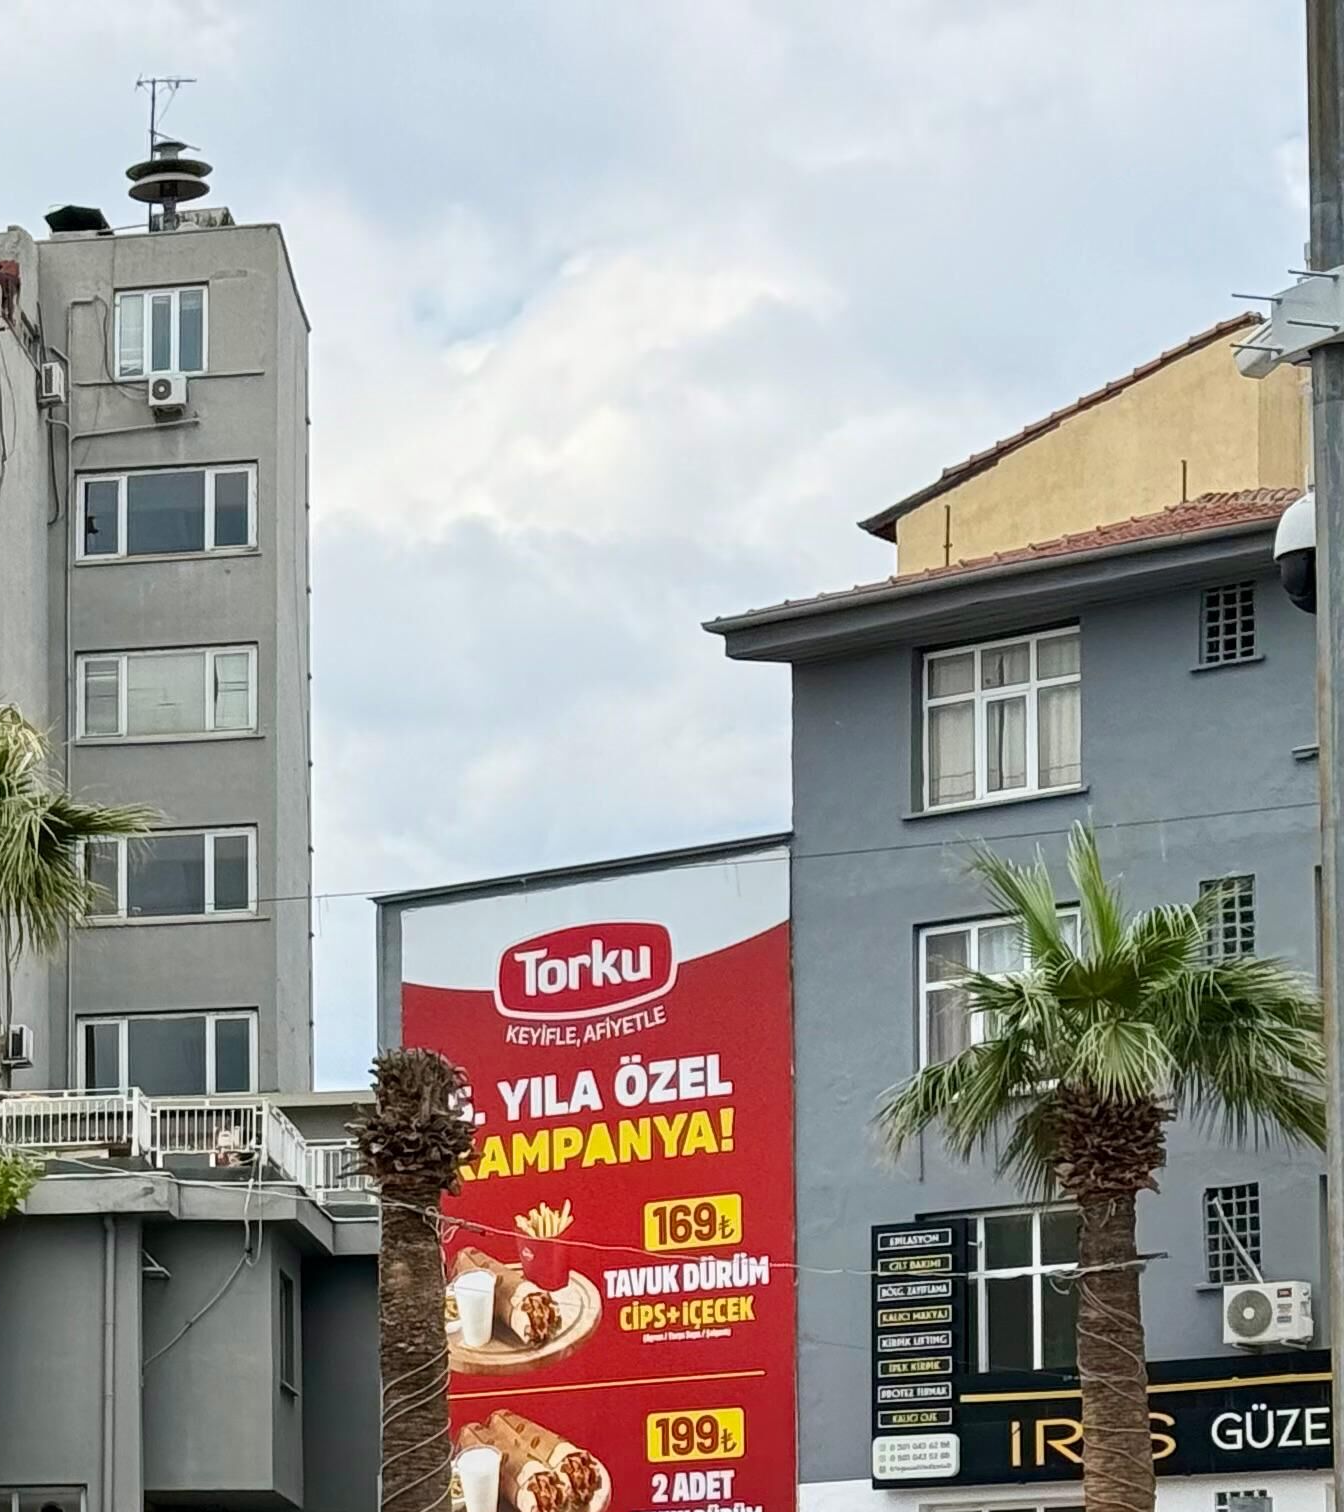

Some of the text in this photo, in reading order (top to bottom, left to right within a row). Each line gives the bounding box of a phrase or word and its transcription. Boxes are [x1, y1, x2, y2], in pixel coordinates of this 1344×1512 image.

[514, 939, 652, 997] Torku
[583, 1005, 667, 1044] AFİYETLE
[497, 1070, 604, 1121] YILA
[614, 1054, 733, 1107] ÖZEL
[603, 1252, 770, 1299] TAVUK DÜRÜM
[651, 1469, 735, 1503] 2 ADET
